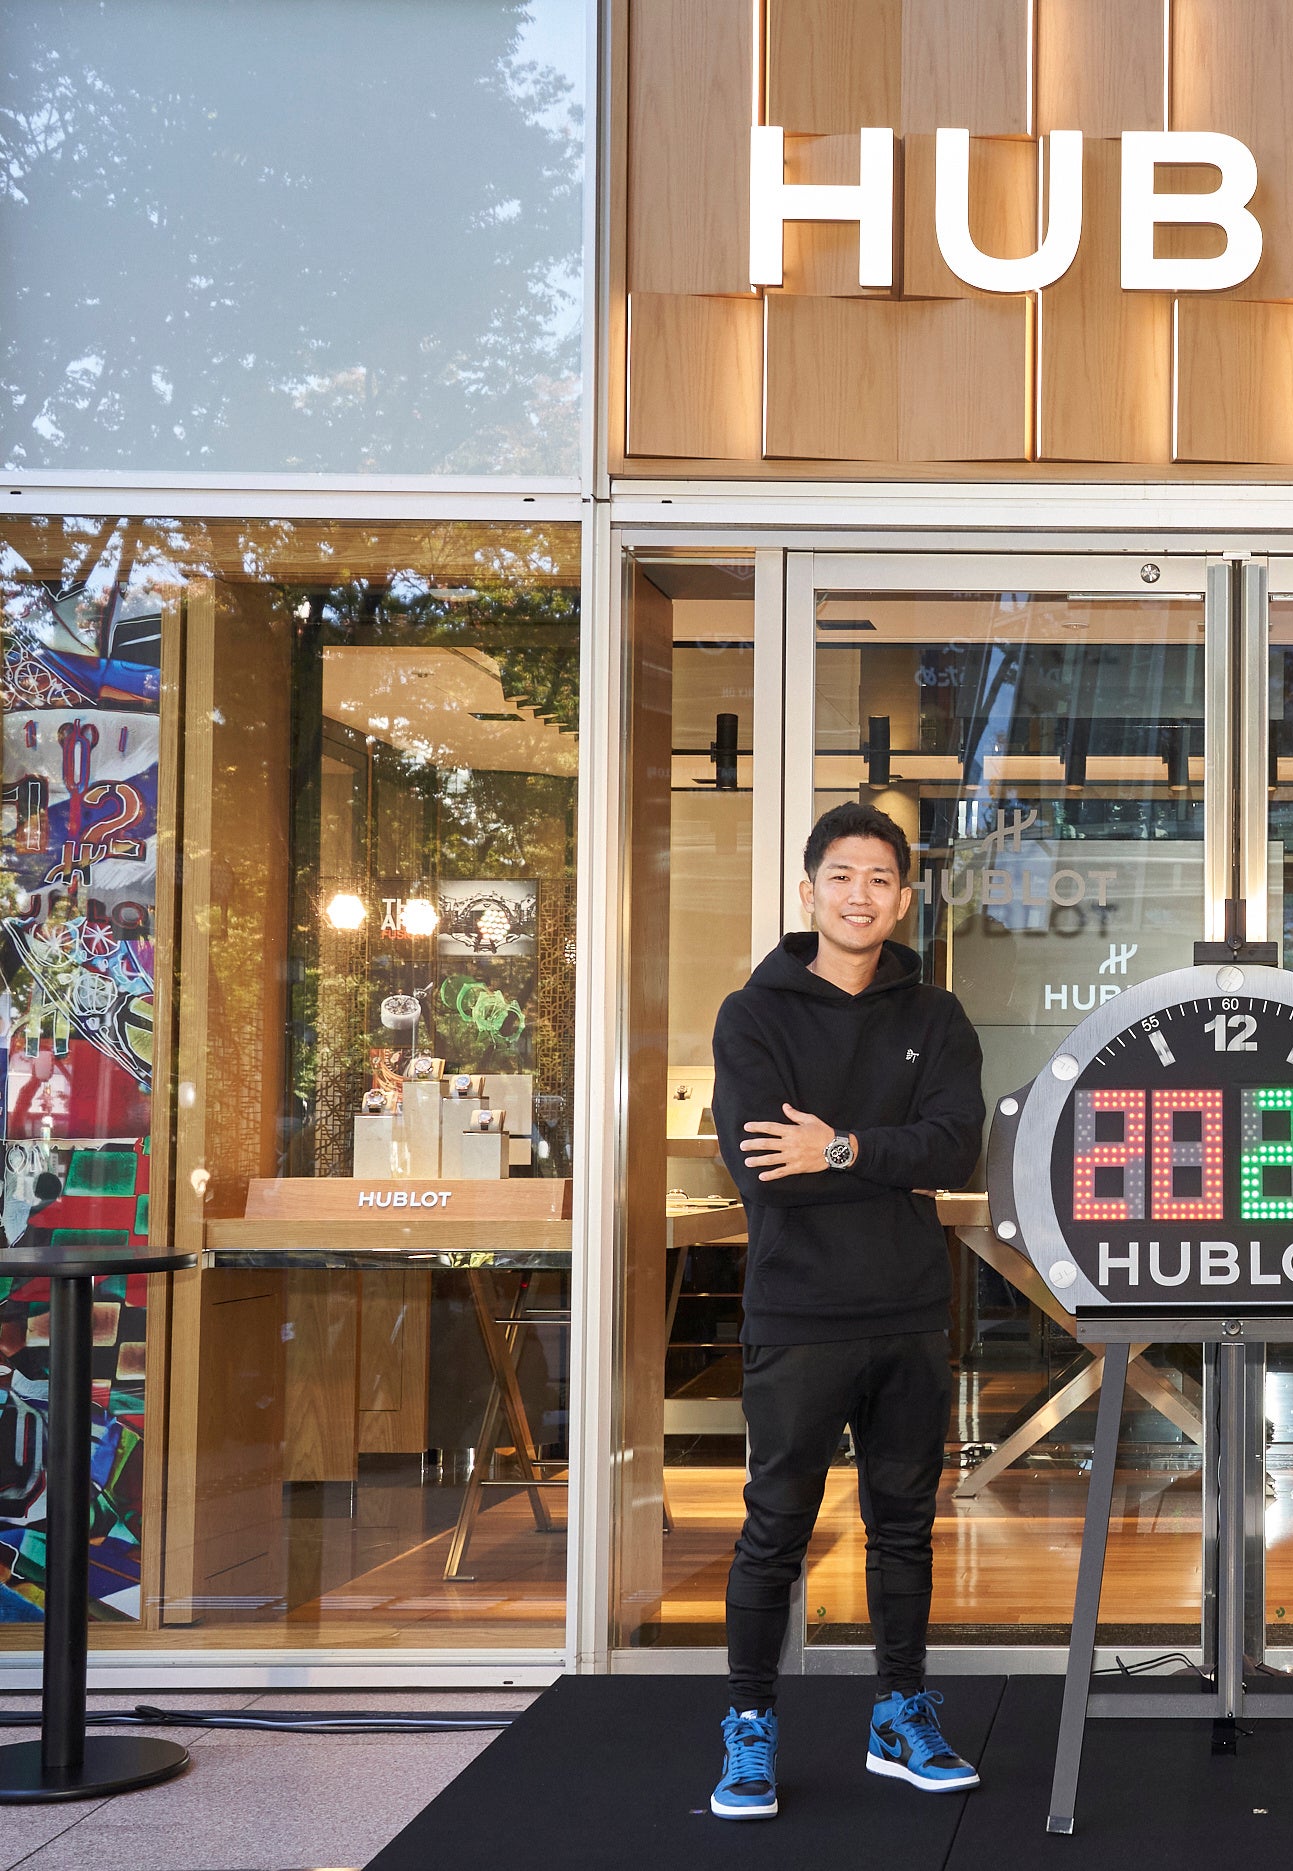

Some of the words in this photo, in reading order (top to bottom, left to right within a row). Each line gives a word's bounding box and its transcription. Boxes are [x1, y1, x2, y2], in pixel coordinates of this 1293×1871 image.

[1044, 985, 1134, 1010] HUB
[1221, 998, 1239, 1011] 60
[1141, 1016, 1160, 1032] 55
[1204, 1014, 1257, 1051] 12
[357, 1191, 452, 1208] HUBLOT
